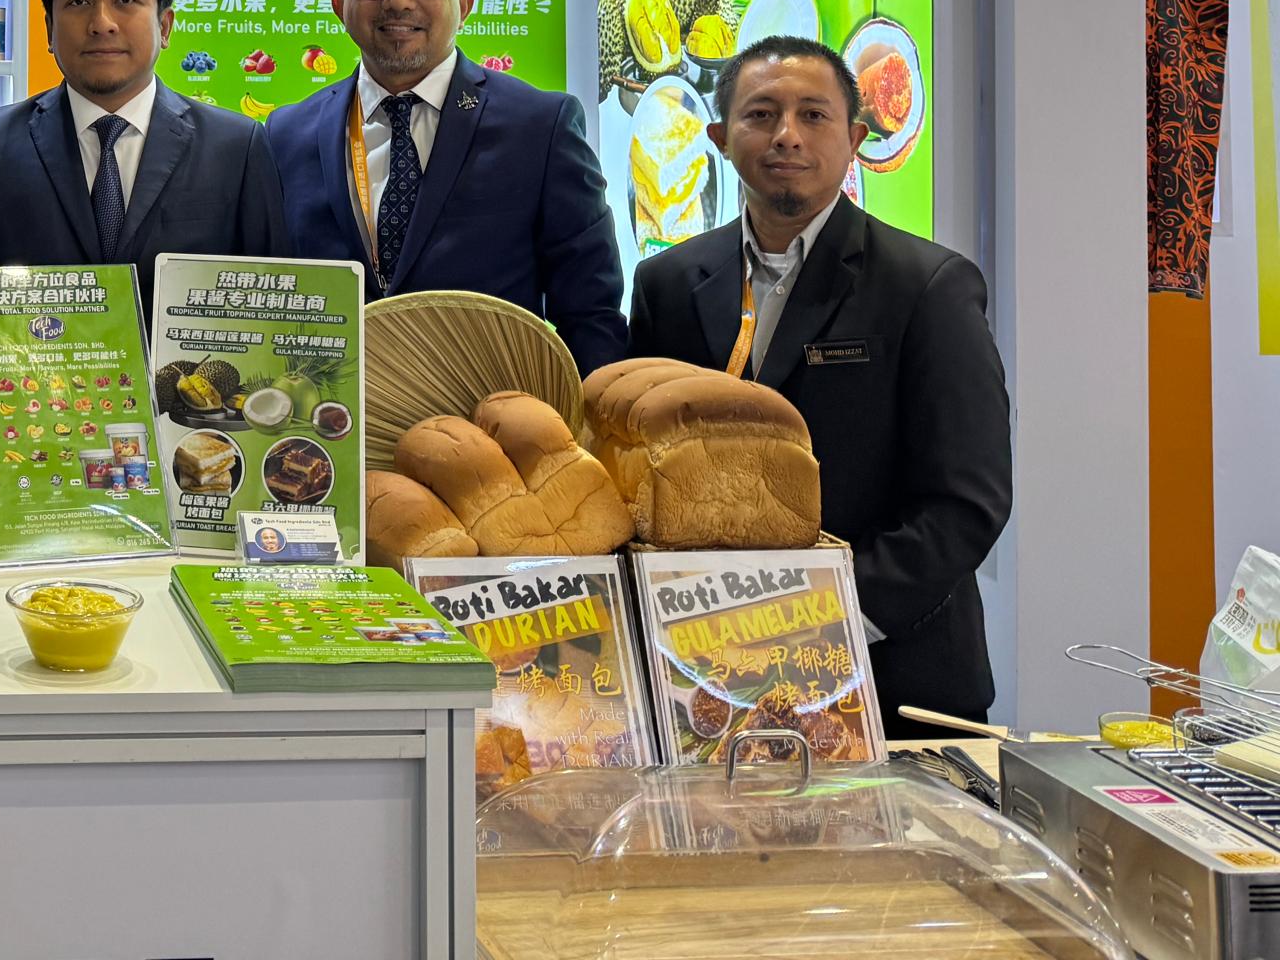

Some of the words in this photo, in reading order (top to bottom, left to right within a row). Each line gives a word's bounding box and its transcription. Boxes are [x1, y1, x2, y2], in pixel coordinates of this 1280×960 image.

[174, 19, 212, 33] More
[218, 19, 267, 35] Fruits,
[272, 20, 310, 34] More
[217, 271, 297, 291] 热带水果
[42, 306, 73, 314] SOLUTION
[75, 305, 105, 313] PARTNER
[187, 290, 326, 311] 果酱专业制造商
[30, 316, 51, 332] Tech
[170, 308, 203, 316] TROPICAL
[205, 309, 224, 317] FRUIT
[226, 311, 255, 319] TOPPING
[258, 312, 284, 320] EXPERT
[286, 313, 343, 323] MANUFACTURER
[41, 322, 64, 340] Food
[186, 507, 223, 520] 烤面包
[431, 585, 495, 621] Roti
[497, 574, 584, 610] Bakar
[657, 576, 719, 615] Roti
[721, 568, 806, 599] Bakar
[473, 599, 600, 653] DURIAN
[707, 643, 852, 681] 马六甲椰糖
[579, 702, 625, 721] Made
[555, 726, 588, 745] with
[594, 726, 629, 745] Real
[784, 730, 828, 749] Mde
[832, 728, 864, 748] with
[561, 753, 634, 768] DURIAN
